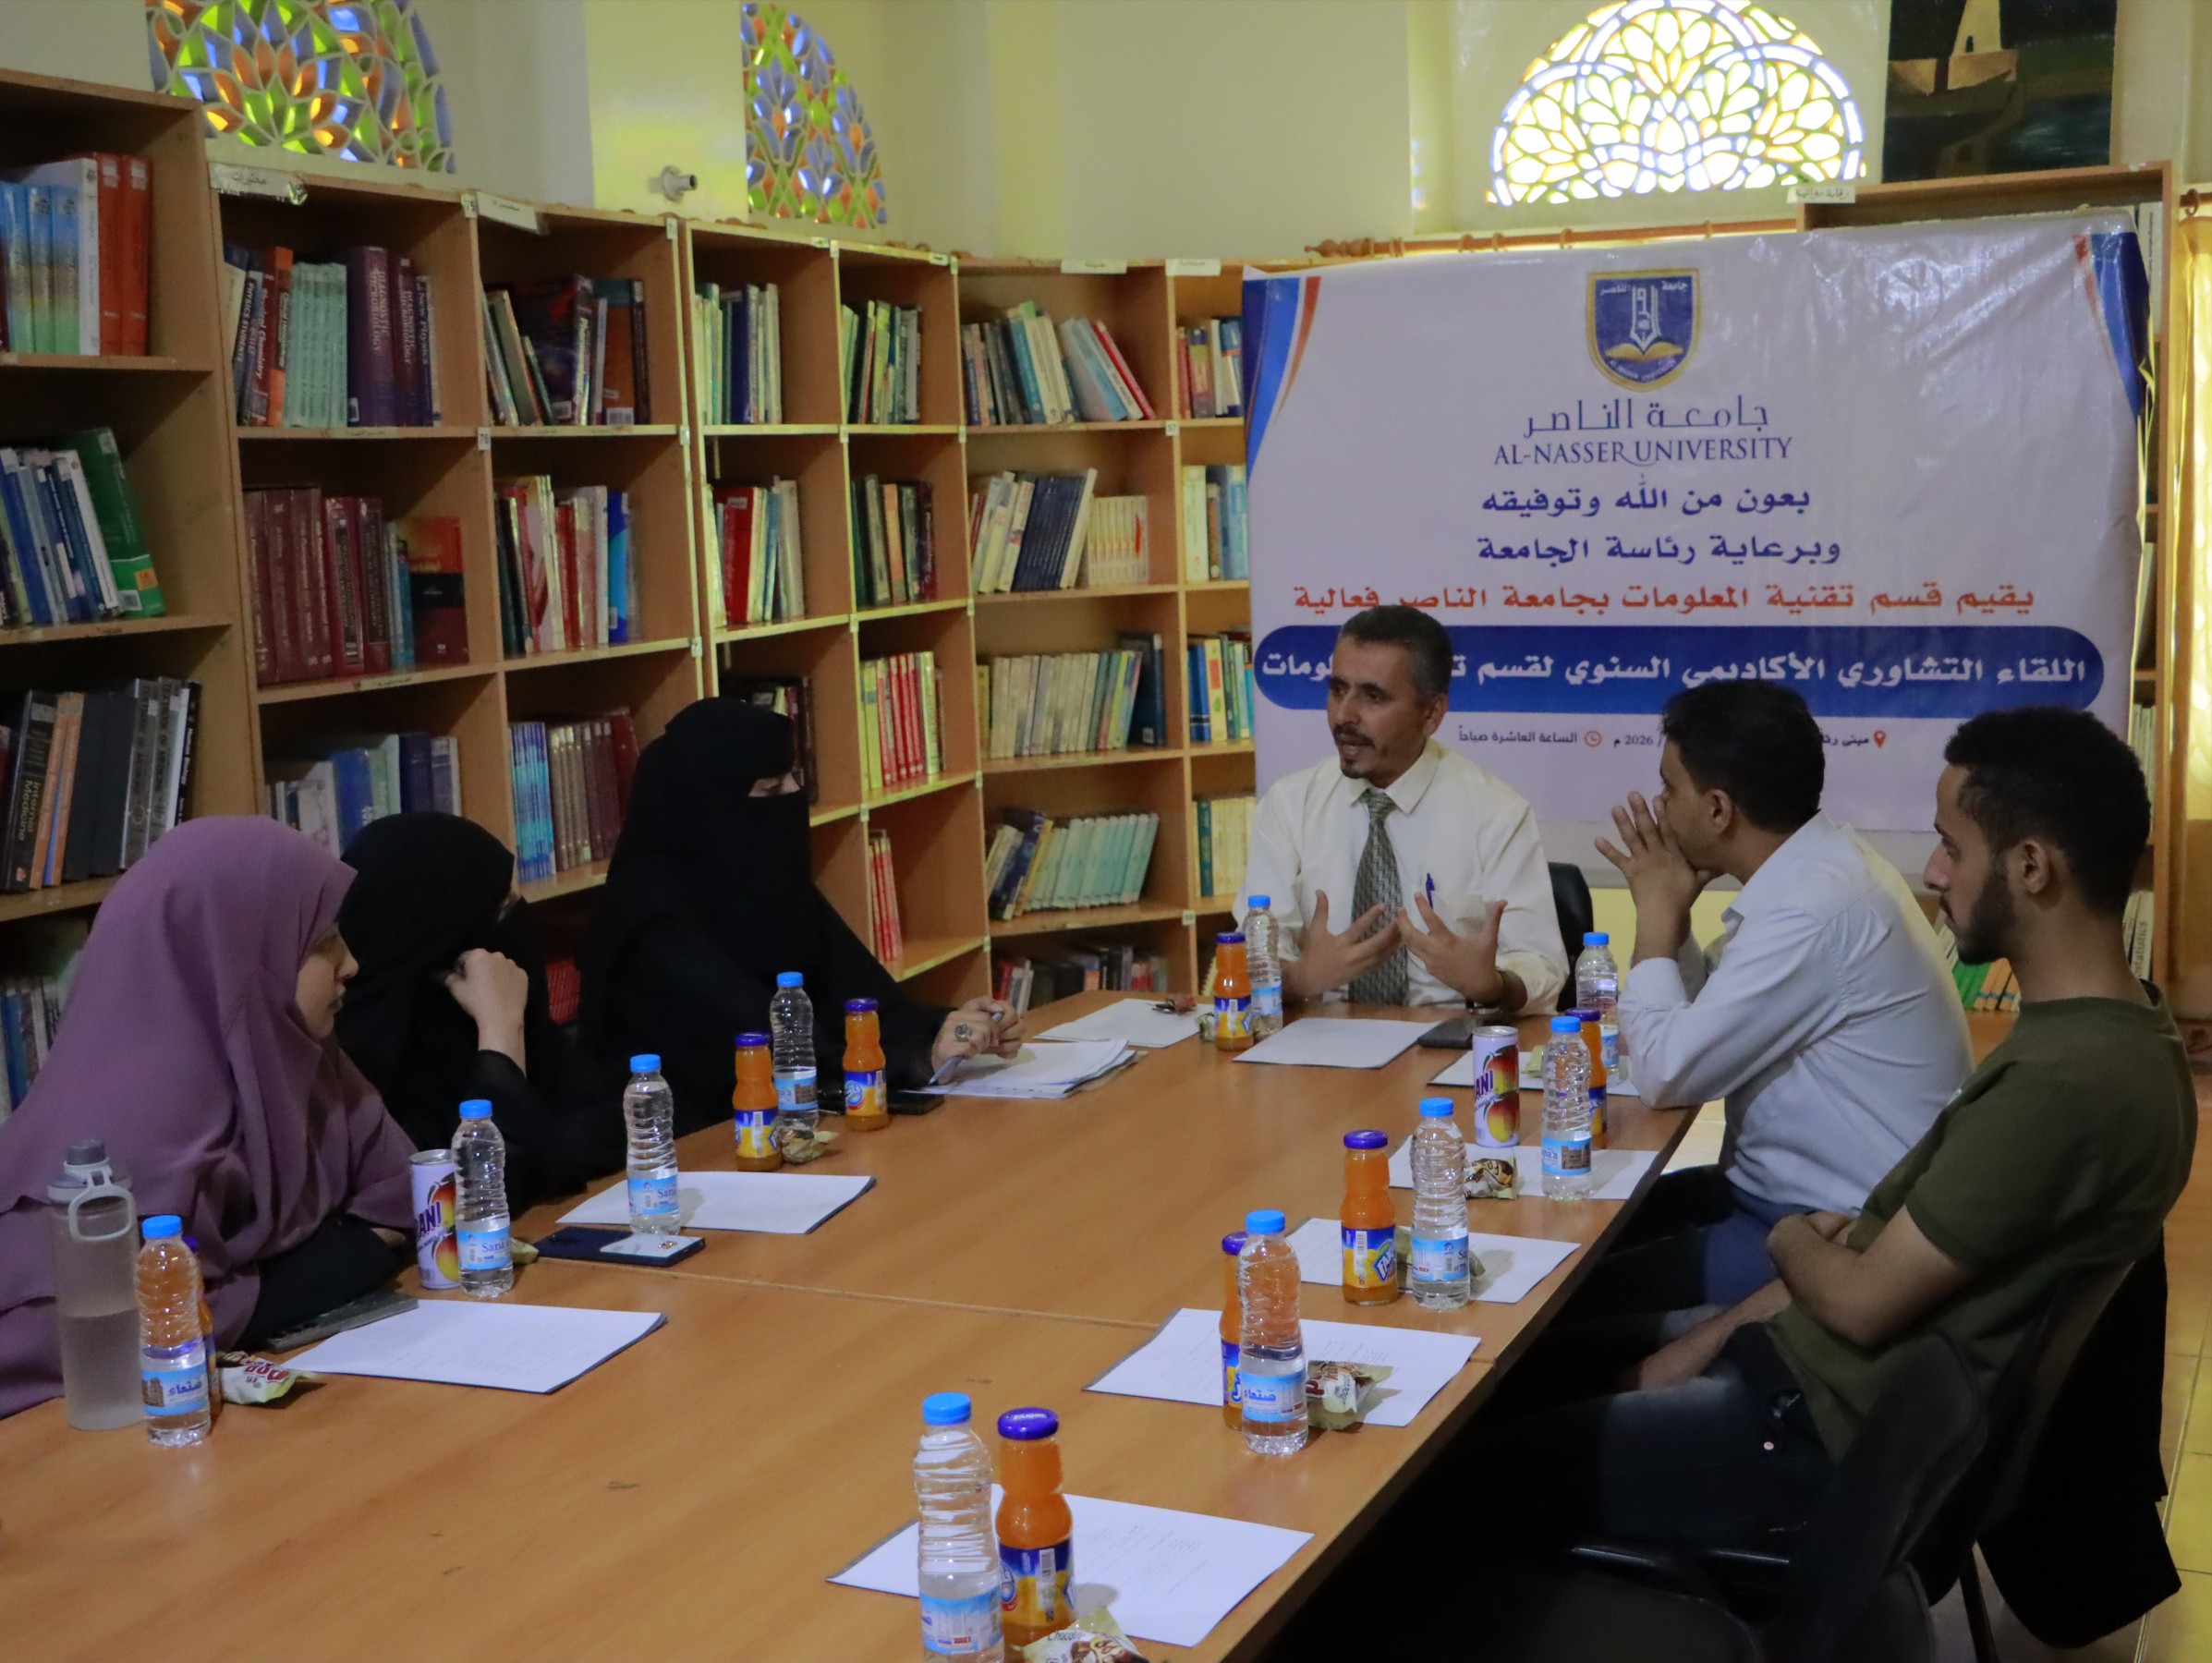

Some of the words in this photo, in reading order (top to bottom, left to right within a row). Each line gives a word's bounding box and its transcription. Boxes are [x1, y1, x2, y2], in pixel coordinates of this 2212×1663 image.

[1523, 398, 1634, 439] الناصر
[1647, 395, 1769, 431] جامعة
[1493, 440, 1631, 466] AL-NASSER
[1636, 437, 1793, 463] UNIVERSITY
[1480, 486, 1601, 519] وتوفيقه
[1614, 473, 1668, 511] الله
[1681, 490, 1723, 516] من
[1735, 488, 1811, 516] بعون
[1477, 536, 1588, 569] الجامعة
[1604, 535, 1695, 564] رئاسة
[1708, 532, 1841, 565] وبرعاية
[1293, 584, 1380, 615] فعالية
[1501, 585, 1609, 616] بجامعة
[1622, 584, 1749, 616] المعلومات
[1765, 583, 1854, 616] تقنية
[1870, 581, 1943, 616] قسم
[1955, 583, 2035, 616] يقيم
[1477, 653, 1555, 685] لقسم
[1563, 654, 1671, 686] السنوي
[1837, 656, 1984, 688] التشاوري
[1996, 656, 2087, 686] اللقاء
[1491, 729, 1537, 745] العاشرة
[1538, 729, 1578, 744] الساعة
[1624, 733, 1654, 747] 2026
[18, 780, 33, 842] Medicine
[28, 782, 42, 832] Internal
[1474, 1070, 1494, 1100] ANI
[415, 1201, 443, 1236] ANI
[1243, 1388, 1277, 1402] صنعاء
